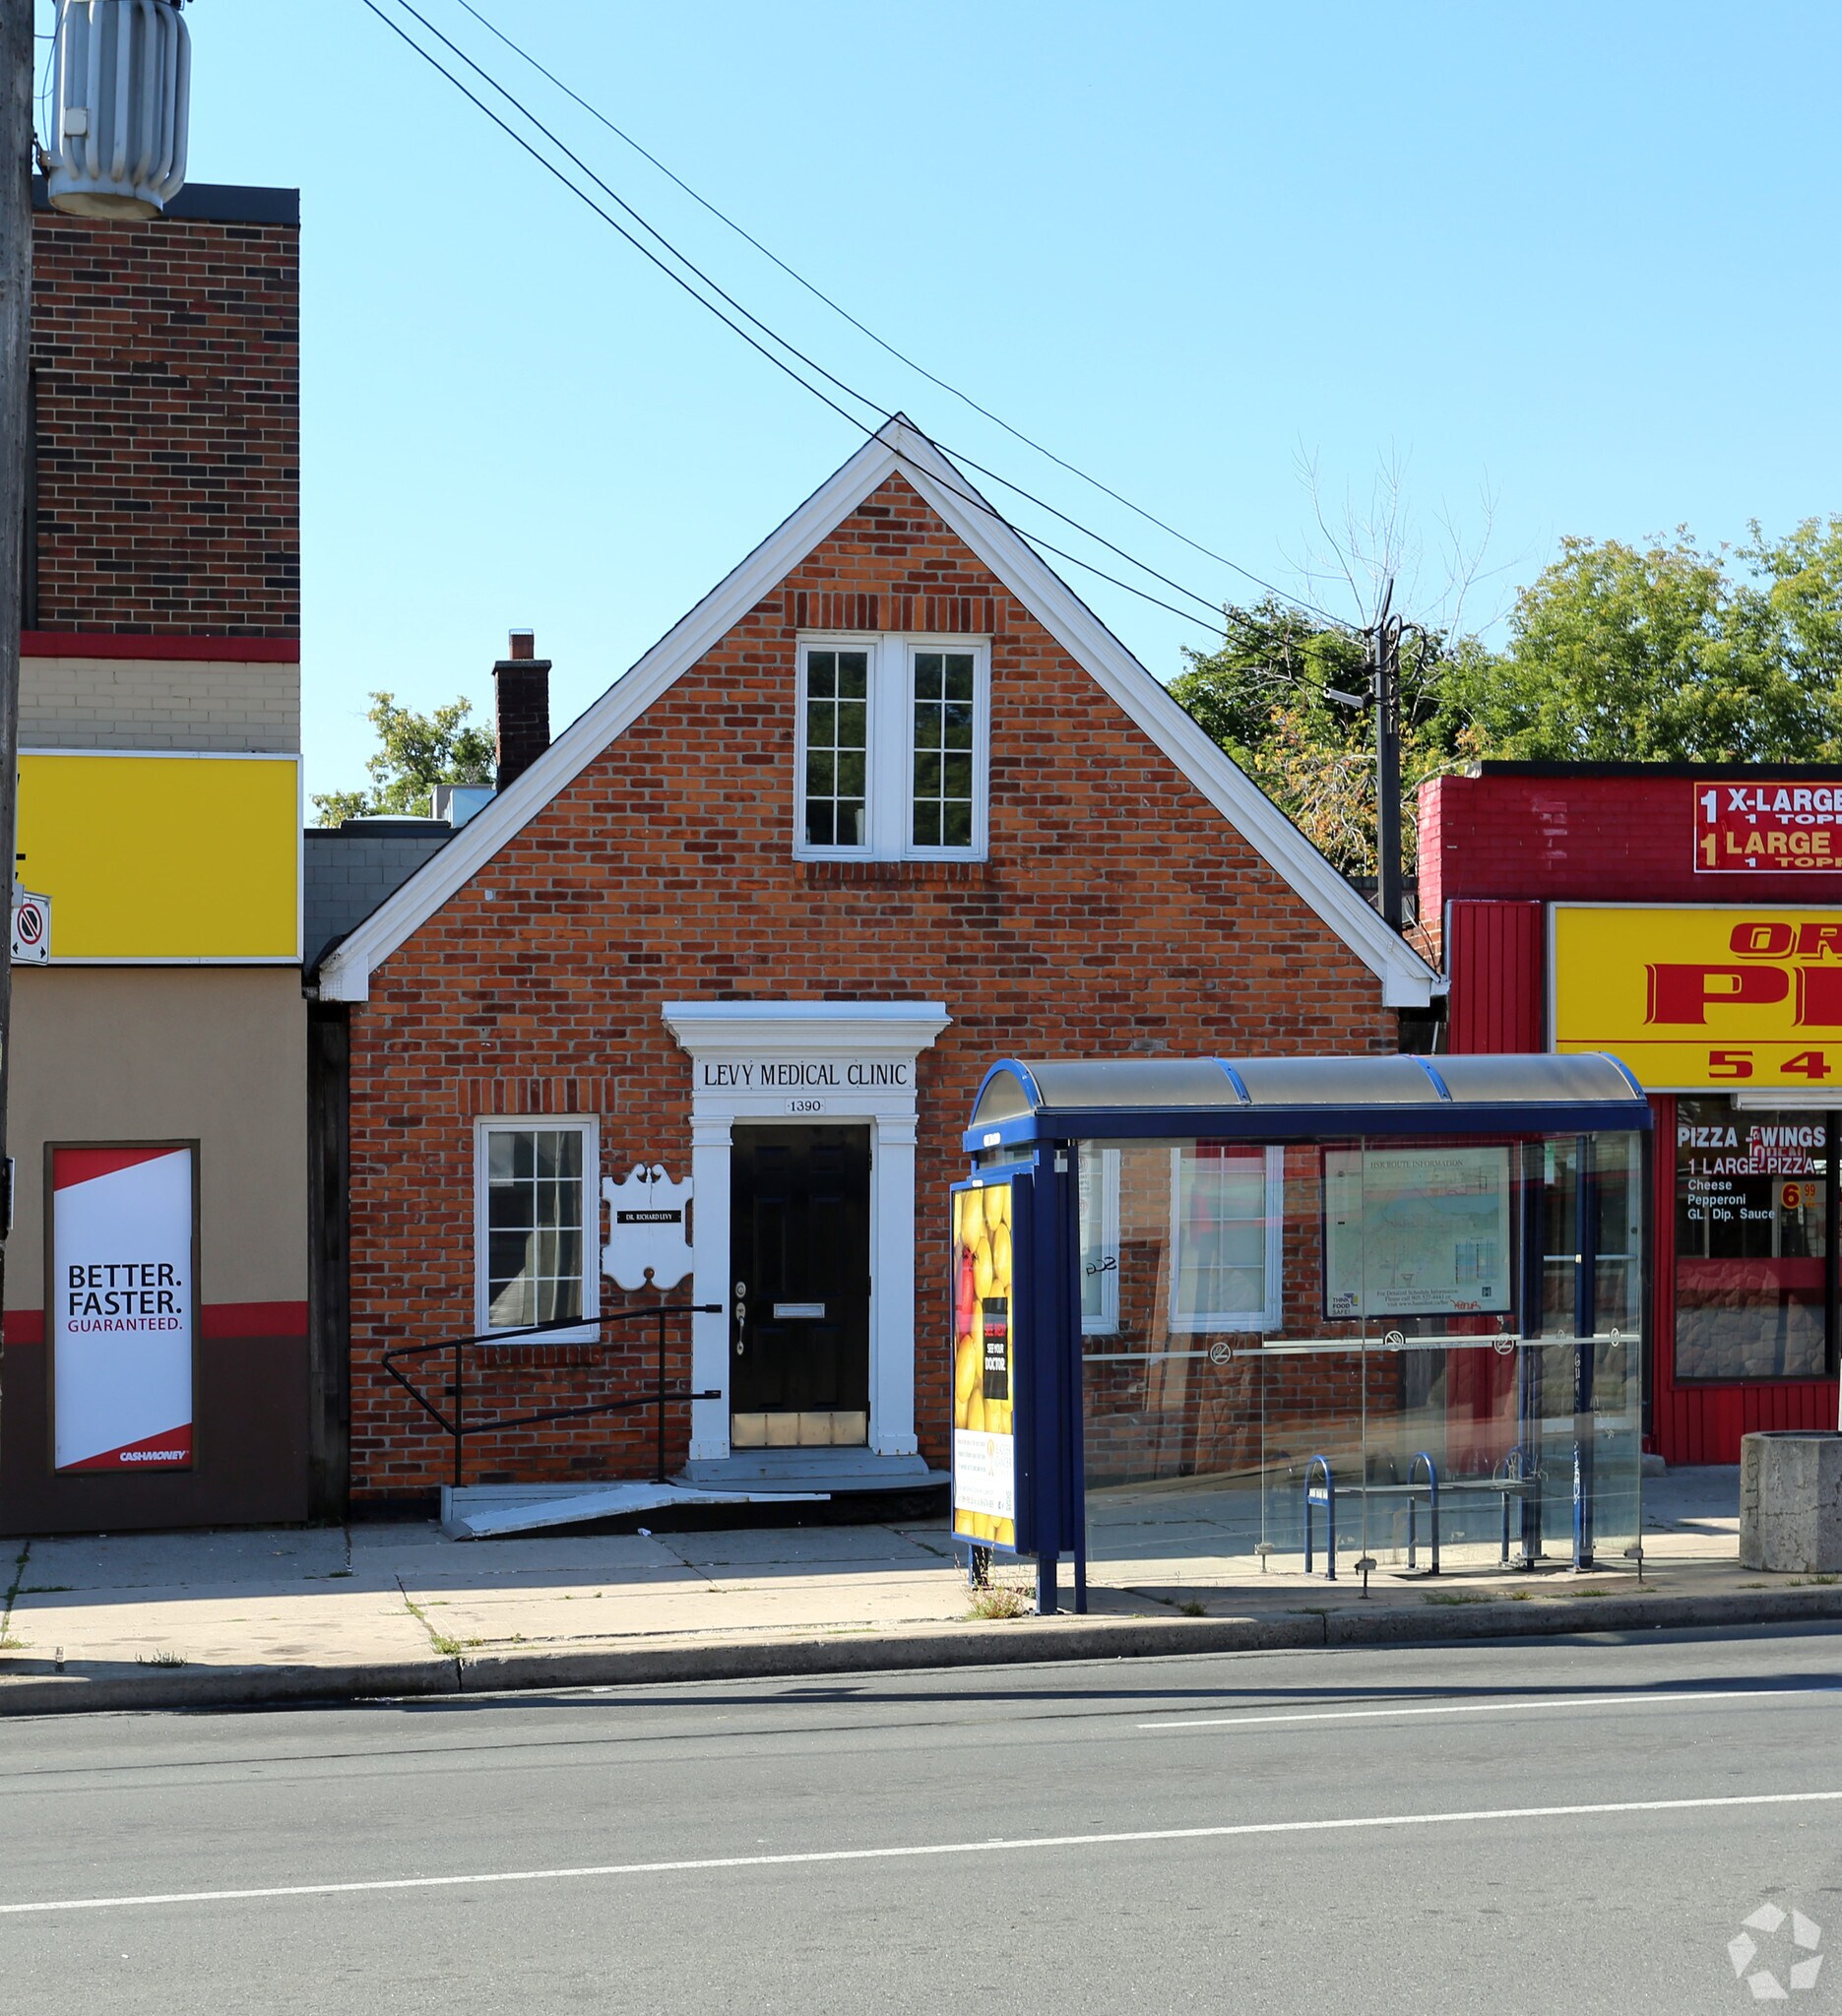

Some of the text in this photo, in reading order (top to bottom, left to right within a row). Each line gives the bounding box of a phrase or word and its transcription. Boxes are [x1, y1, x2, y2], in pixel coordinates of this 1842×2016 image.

[1700, 789, 1717, 823] 1
[1745, 813, 1757, 824] 1
[1700, 831, 1831, 866] 1 LARGE
[1745, 857, 1756, 867] 1
[1730, 922, 1842, 960] OR
[704, 1063, 907, 1086] LEVY MEDICAL CLINIC
[1677, 1126, 1739, 1148] PIZZA
[1760, 1125, 1826, 1148] WINGS
[1386, 1160, 1409, 1168] ROUTE
[1412, 1159, 1464, 1167] INFORMATION
[1687, 1157, 1816, 1175] 1 LARGE PIZZA
[1687, 1178, 1733, 1191] Cheese
[1687, 1193, 1747, 1208] Pepperoni
[1780, 1181, 1802, 1210] 6
[1687, 1208, 1776, 1222] GL. Dip. Sauce
[69, 1263, 182, 1289] BETTER.
[69, 1290, 182, 1316] FASTER.
[68, 1317, 183, 1333] GUARANTEED.
[119, 1450, 186, 1462] CASHMONEY
